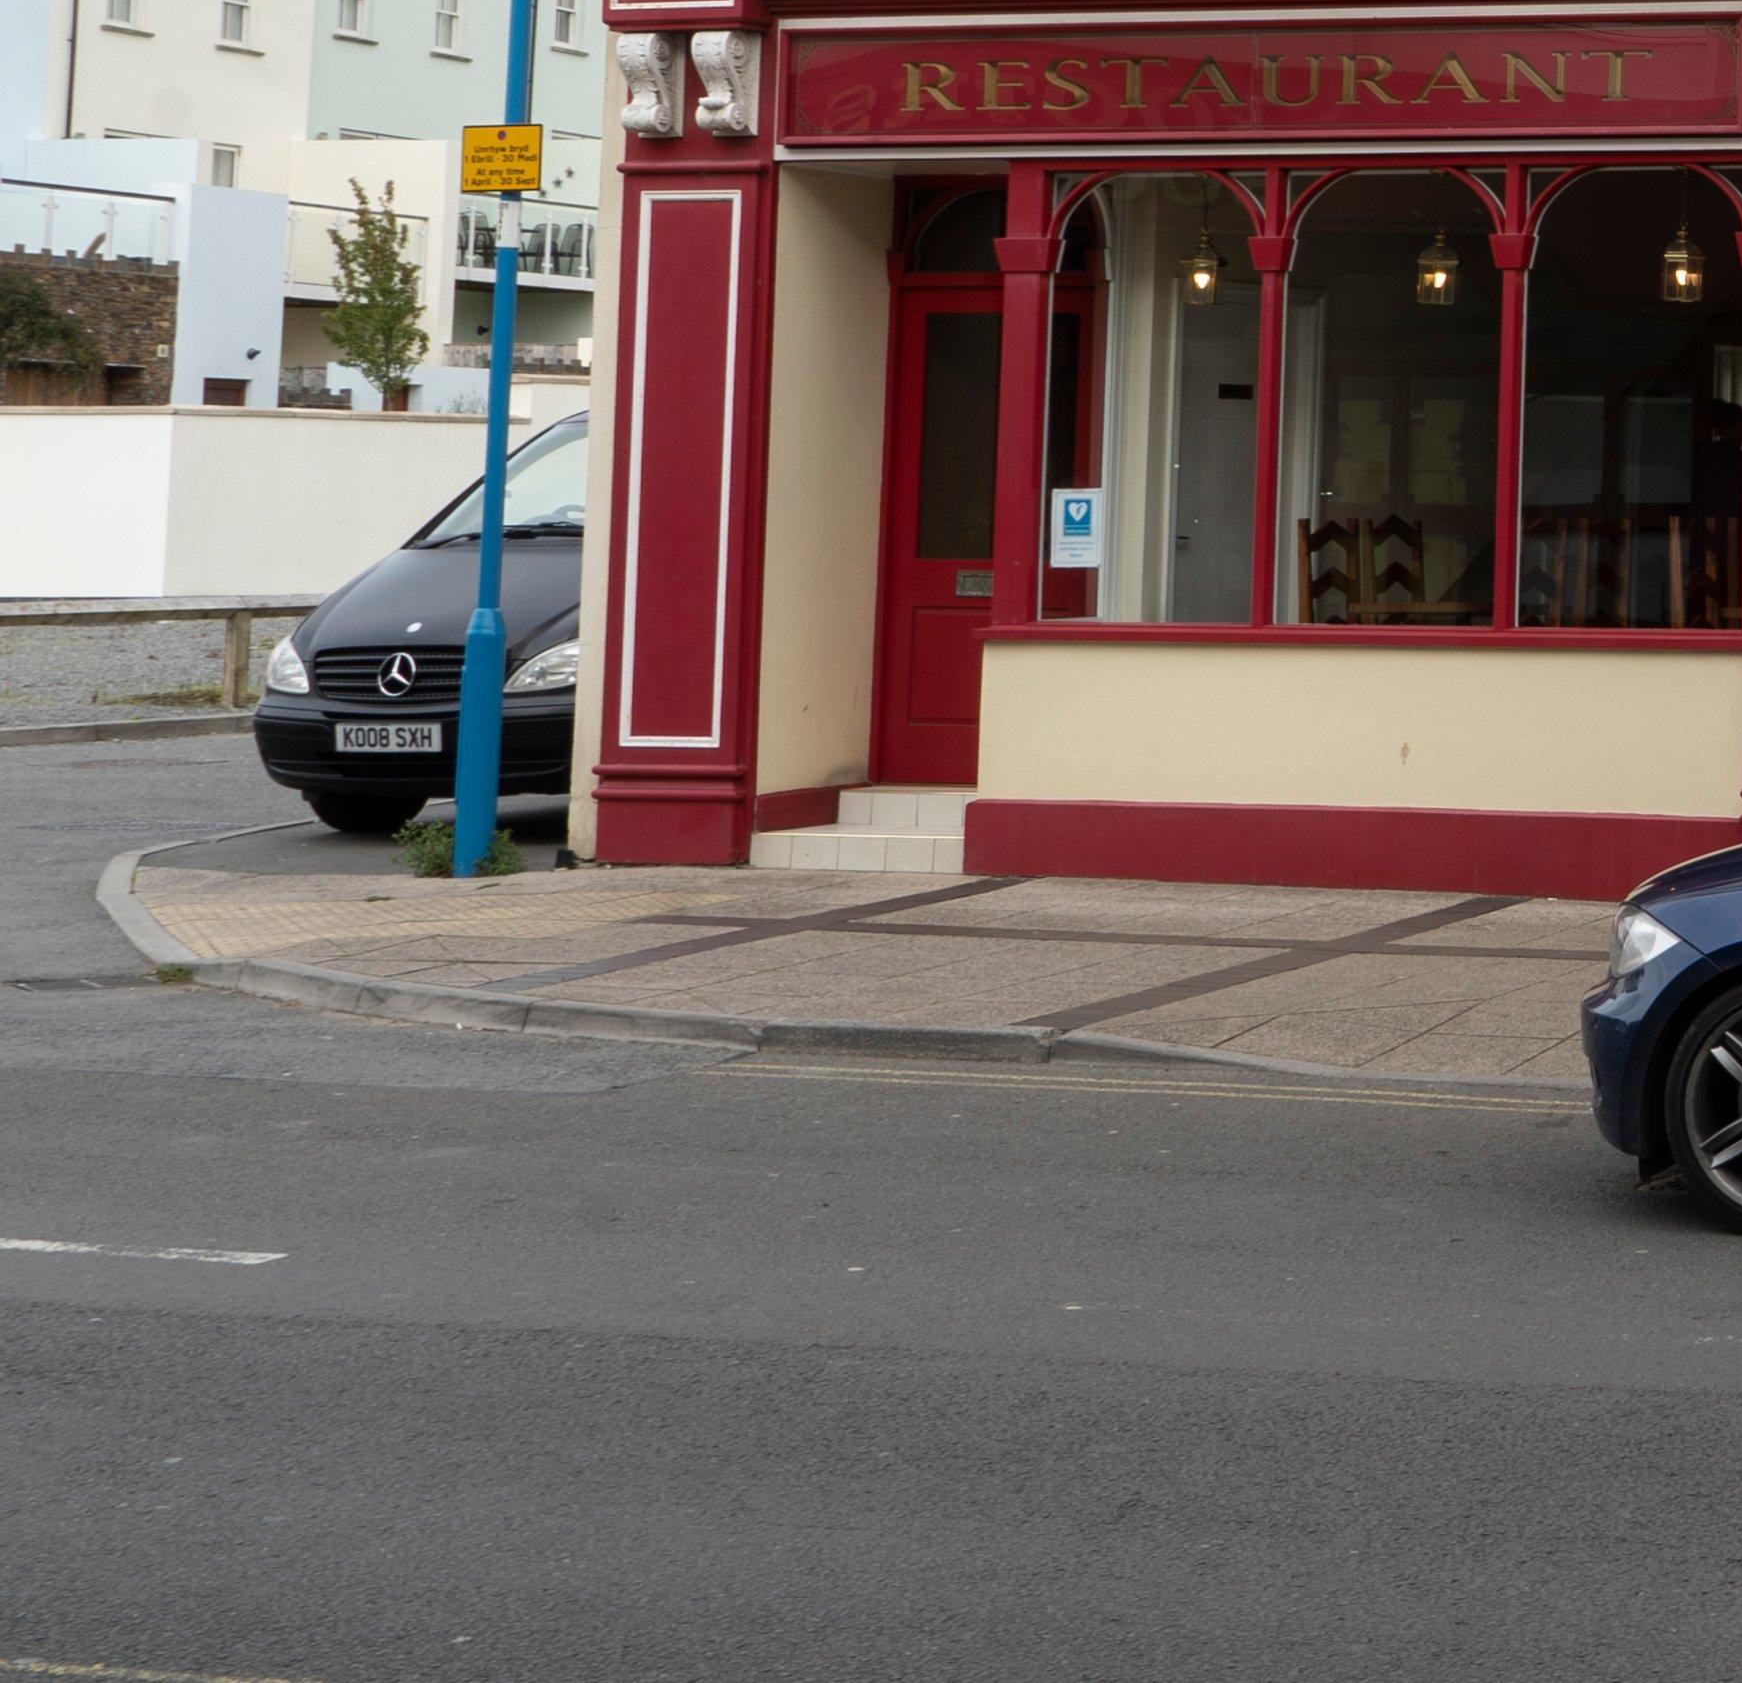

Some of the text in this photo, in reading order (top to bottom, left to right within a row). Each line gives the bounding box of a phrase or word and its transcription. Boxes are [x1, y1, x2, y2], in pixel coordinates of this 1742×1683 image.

[899, 49, 1653, 113] RESTAURANT
[509, 144, 529, 154] bryd
[502, 154, 516, 163] 30
[518, 153, 538, 162] Medi
[476, 167, 525, 177] At any time
[471, 177, 491, 186] April
[501, 177, 513, 185] 30
[516, 176, 536, 186] Sept
[395, 727, 432, 748] SXH
